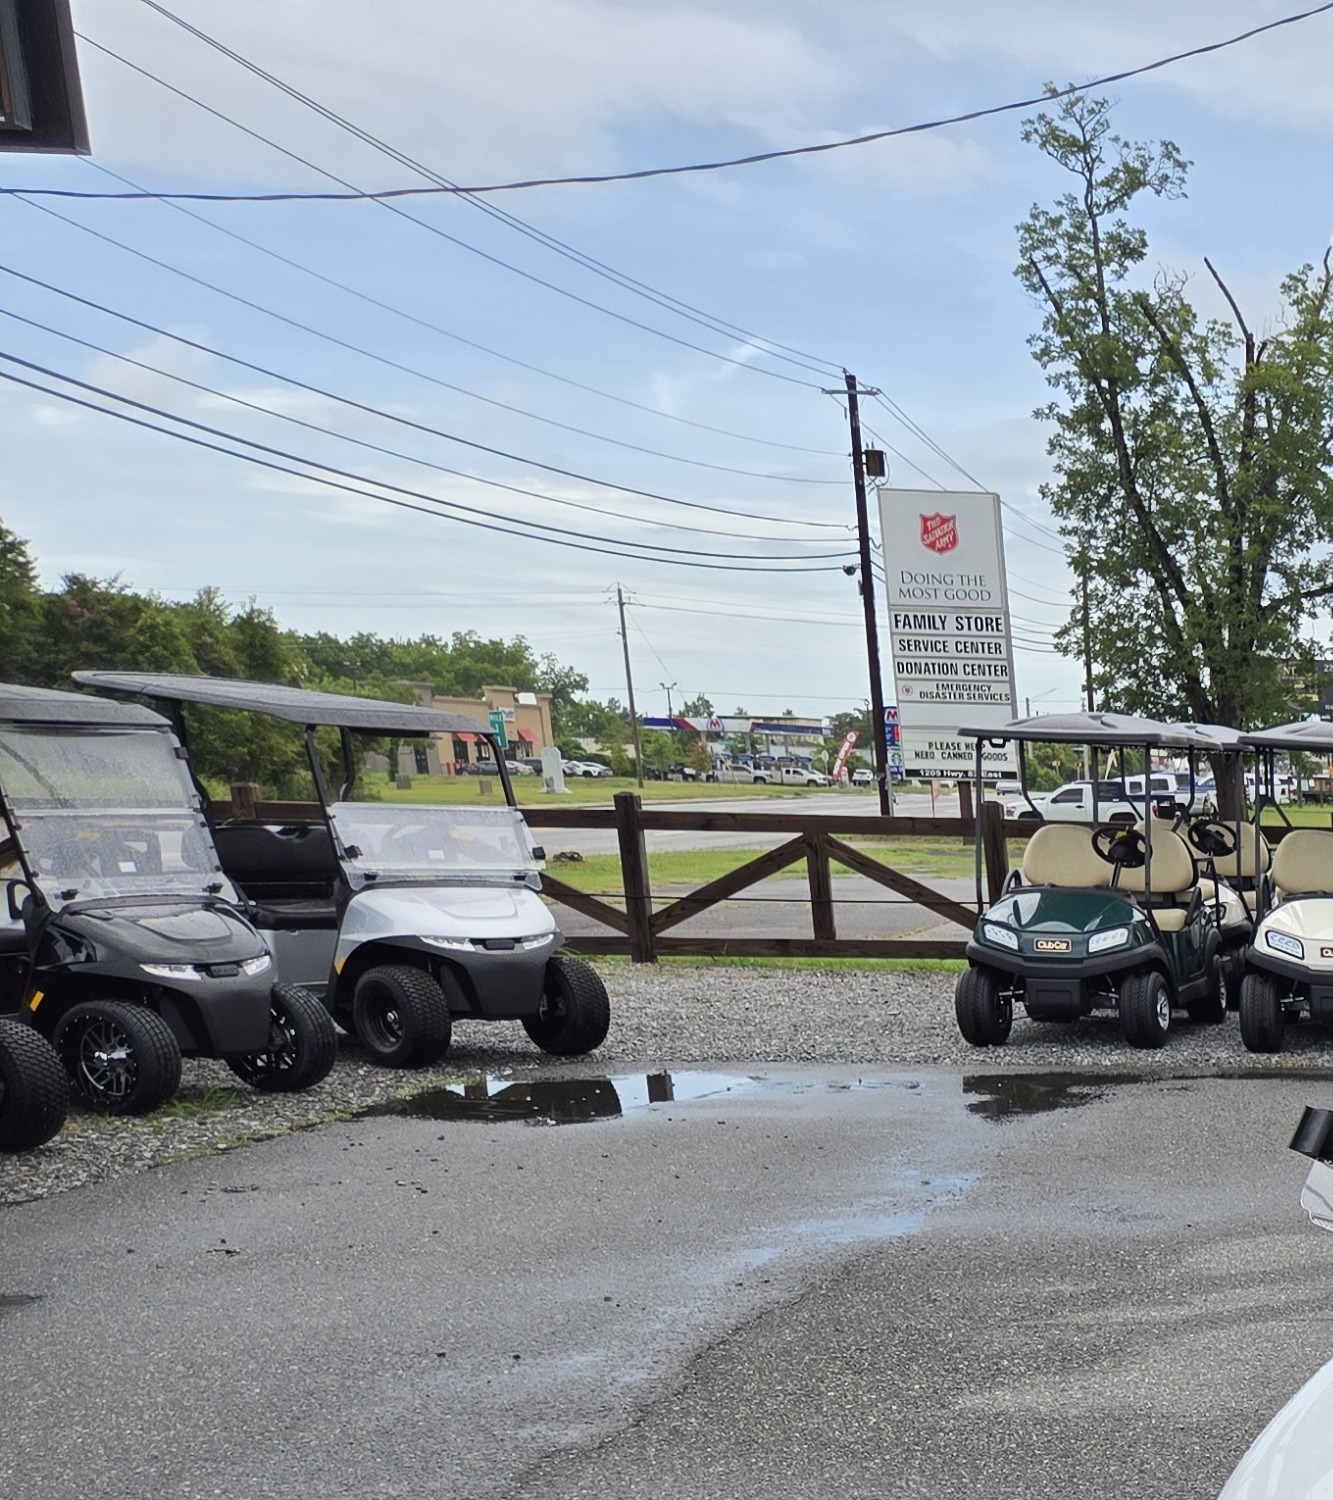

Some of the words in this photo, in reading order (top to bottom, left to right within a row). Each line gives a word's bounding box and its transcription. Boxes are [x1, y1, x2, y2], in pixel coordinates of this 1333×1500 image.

[901, 570, 954, 586] DOING
[957, 574, 987, 587] THE
[898, 587, 940, 600] MOST
[944, 588, 991, 601] GOOD
[893, 613, 947, 631] FAMILY
[955, 615, 1003, 633] STORE
[898, 639, 950, 654] SERVICE
[955, 640, 1003, 655] CENTER
[896, 661, 959, 676] DONATION
[962, 663, 1008, 677] CENTER
[935, 683, 992, 693] EMERGENCY
[919, 691, 965, 700] DISASTER
[966, 693, 1010, 702] SERVICES
[928, 741, 962, 751] PLEASE
[964, 742, 985, 751] HE
[914, 751, 935, 760] NEED
[941, 751, 974, 760] CANNED
[981, 752, 1008, 762] GOODS
